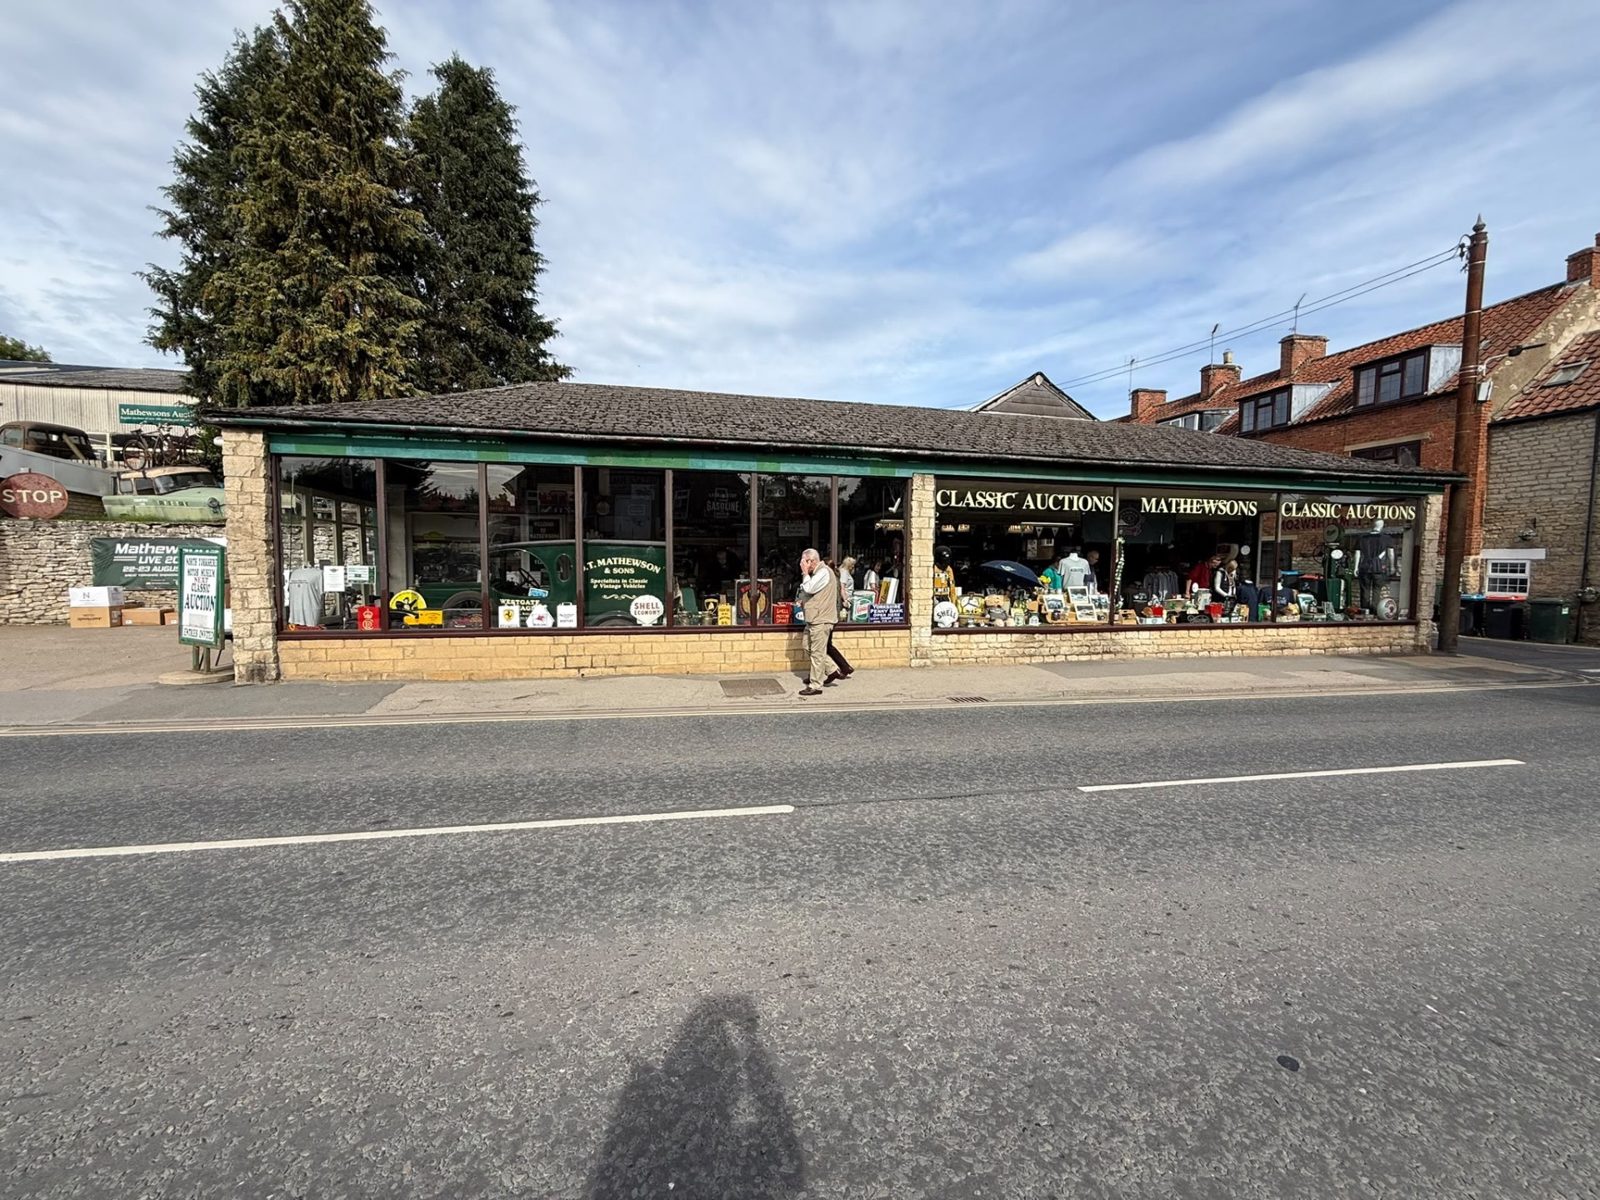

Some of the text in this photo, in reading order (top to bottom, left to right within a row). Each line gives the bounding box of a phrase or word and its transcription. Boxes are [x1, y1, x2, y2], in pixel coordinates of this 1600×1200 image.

[120, 407, 171, 418] Mathewsons
[2, 488, 63, 503] STOP
[936, 489, 1114, 512] CLASSIC AUCTIONS
[706, 500, 740, 513] GASOLINE
[1140, 497, 1258, 516] MATHEWSONS
[1281, 501, 1416, 520] CLASSIC AUCTIONS
[115, 542, 178, 554] Mathew
[138, 555, 178, 564] LIVE 20
[583, 556, 661, 574] .T. MATHEWSON
[152, 565, 178, 573] AUGUS
[191, 583, 211, 593] CLASSIC
[184, 593, 217, 611] AUCTION
[634, 602, 660, 610] SHELL
[936, 609, 956, 619] SHELL
